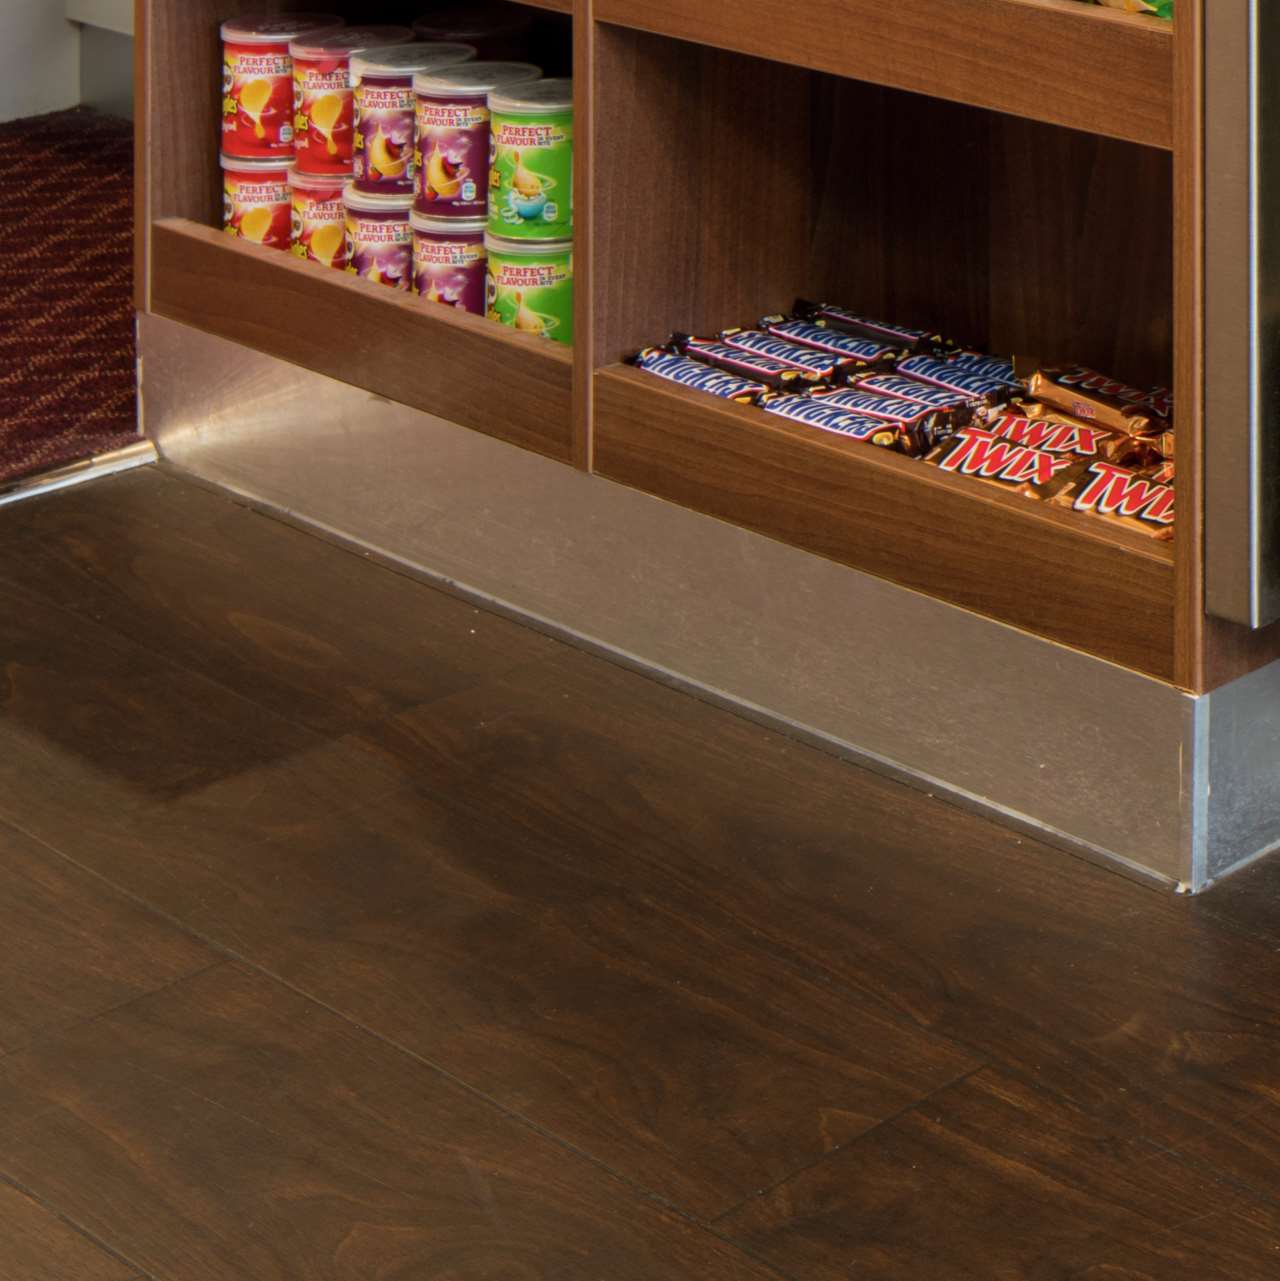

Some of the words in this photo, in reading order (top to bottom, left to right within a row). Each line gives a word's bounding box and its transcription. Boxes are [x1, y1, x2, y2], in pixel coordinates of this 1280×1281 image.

[309, 72, 350, 81] PERFEC
[309, 202, 345, 211] PERFE
[938, 425, 1073, 485] TWIX
[990, 412, 1112, 455] TWIX
[1073, 461, 1175, 523] TWI
